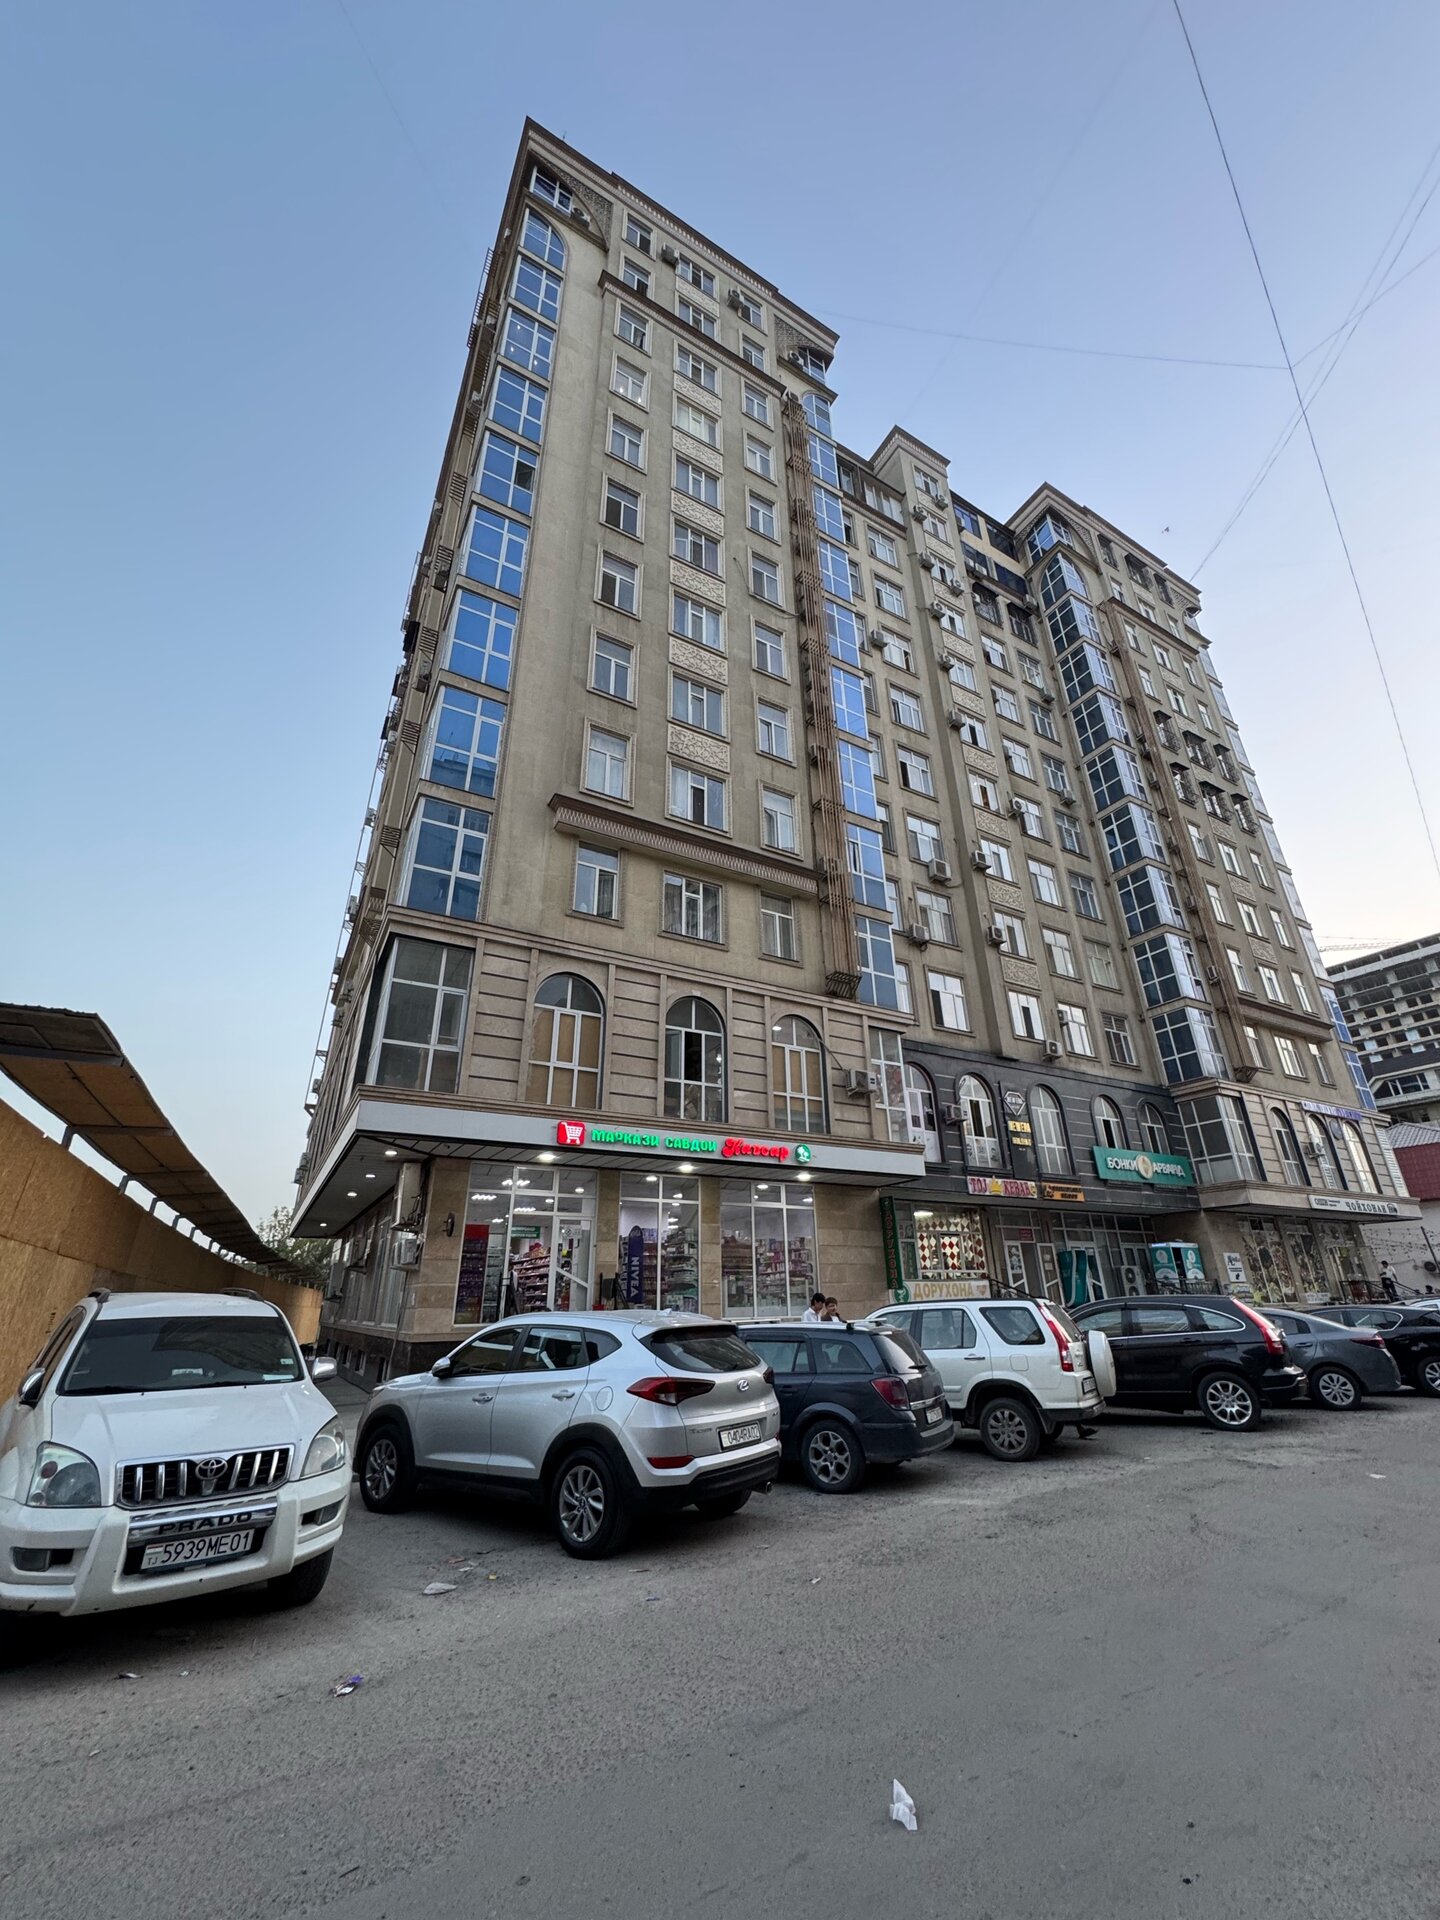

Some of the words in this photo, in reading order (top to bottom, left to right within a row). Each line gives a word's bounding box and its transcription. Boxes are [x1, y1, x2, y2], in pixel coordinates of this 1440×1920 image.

[591, 1129, 660, 1147] МАРКАЗИ
[665, 1136, 717, 1152] САВДОИ
[1107, 1156, 1139, 1171] БОНКИ
[969, 1178, 988, 1193] TOJ
[630, 1256, 640, 1297] NIVEA
[913, 1282, 975, 1299] ДОРУХОНА
[157, 1512, 252, 1535] PRADO
[160, 1531, 250, 1564] 5939ME01
